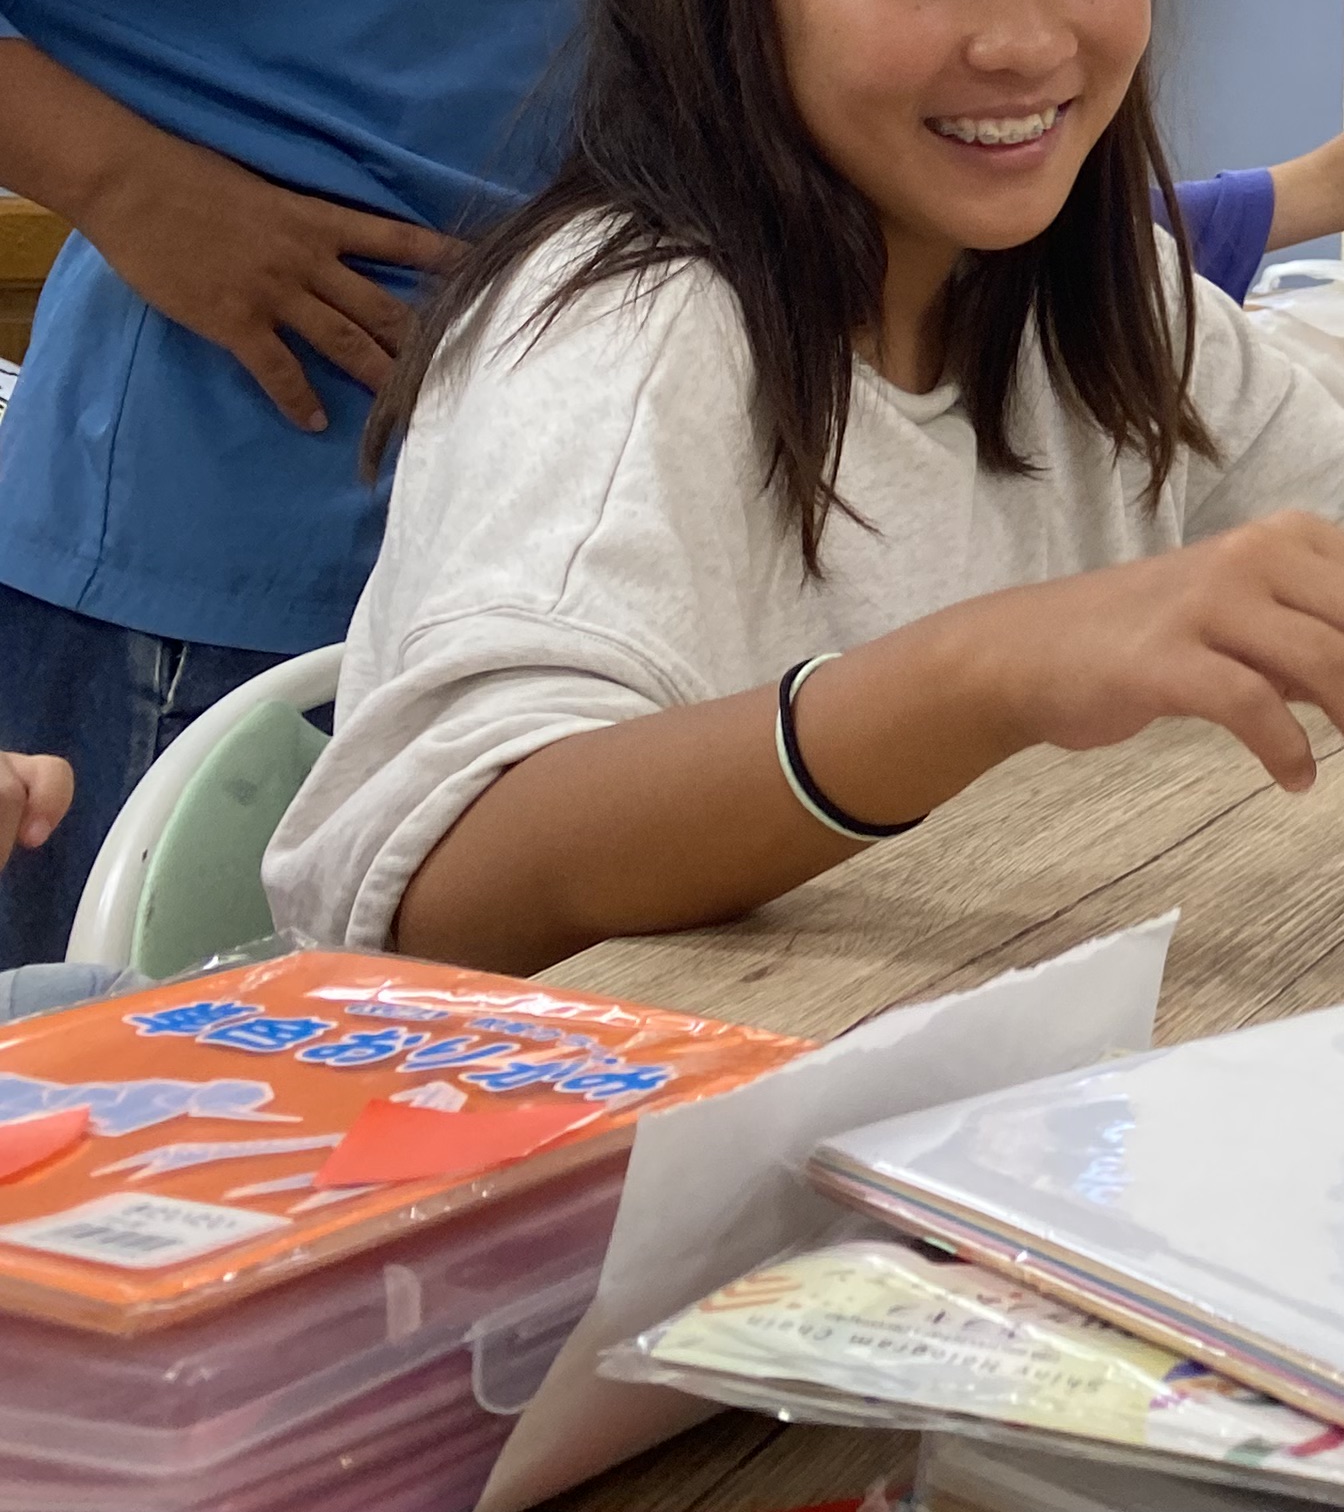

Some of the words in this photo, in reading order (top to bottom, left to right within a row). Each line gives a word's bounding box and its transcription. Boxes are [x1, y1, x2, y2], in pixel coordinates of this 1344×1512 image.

[126, 1000, 674, 1100] 単色おりがみ
